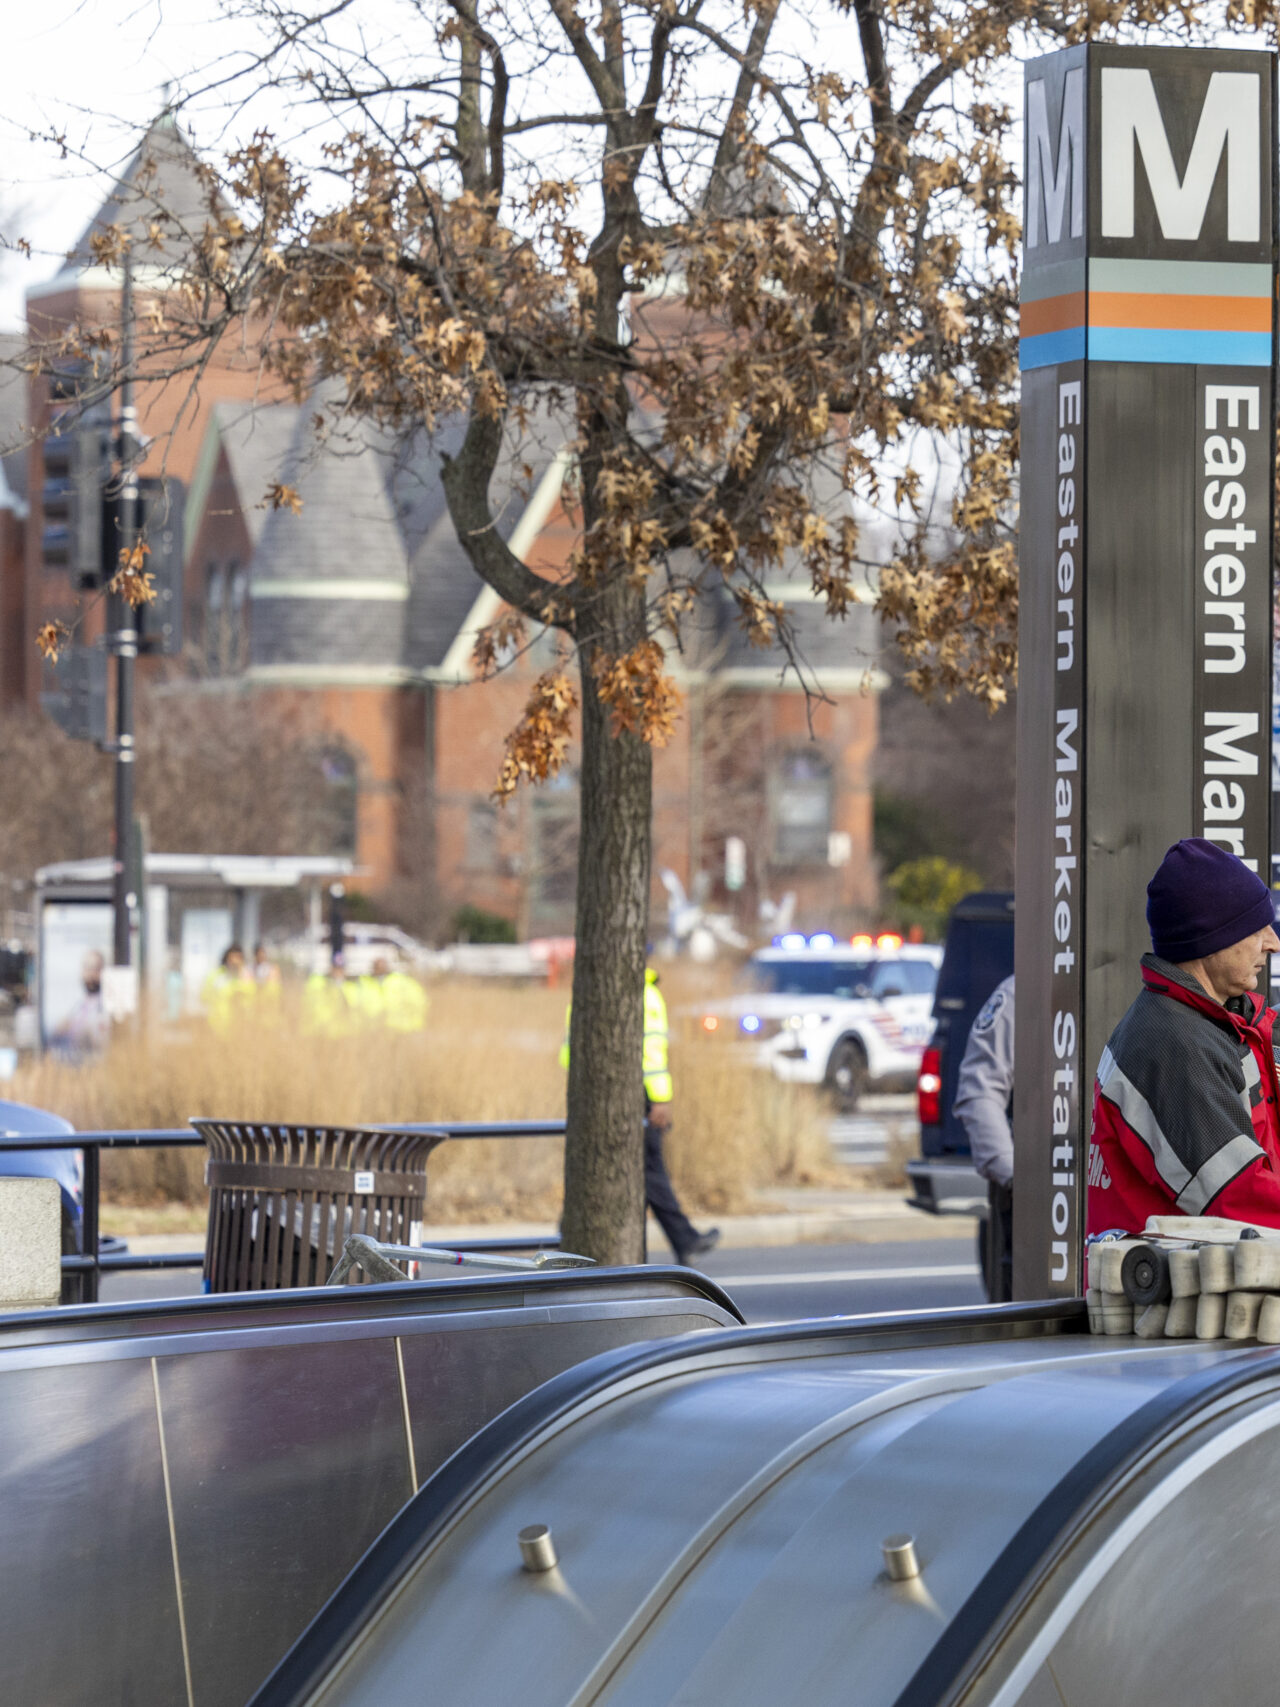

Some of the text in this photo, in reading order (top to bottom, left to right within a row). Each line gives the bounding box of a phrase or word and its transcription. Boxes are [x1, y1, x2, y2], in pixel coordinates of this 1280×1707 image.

[1026, 67, 1083, 249] M
[1101, 67, 1260, 242] M
[1202, 385, 1260, 874] Eastern Mar
[1051, 381, 1081, 1282] Eastern Market Station
